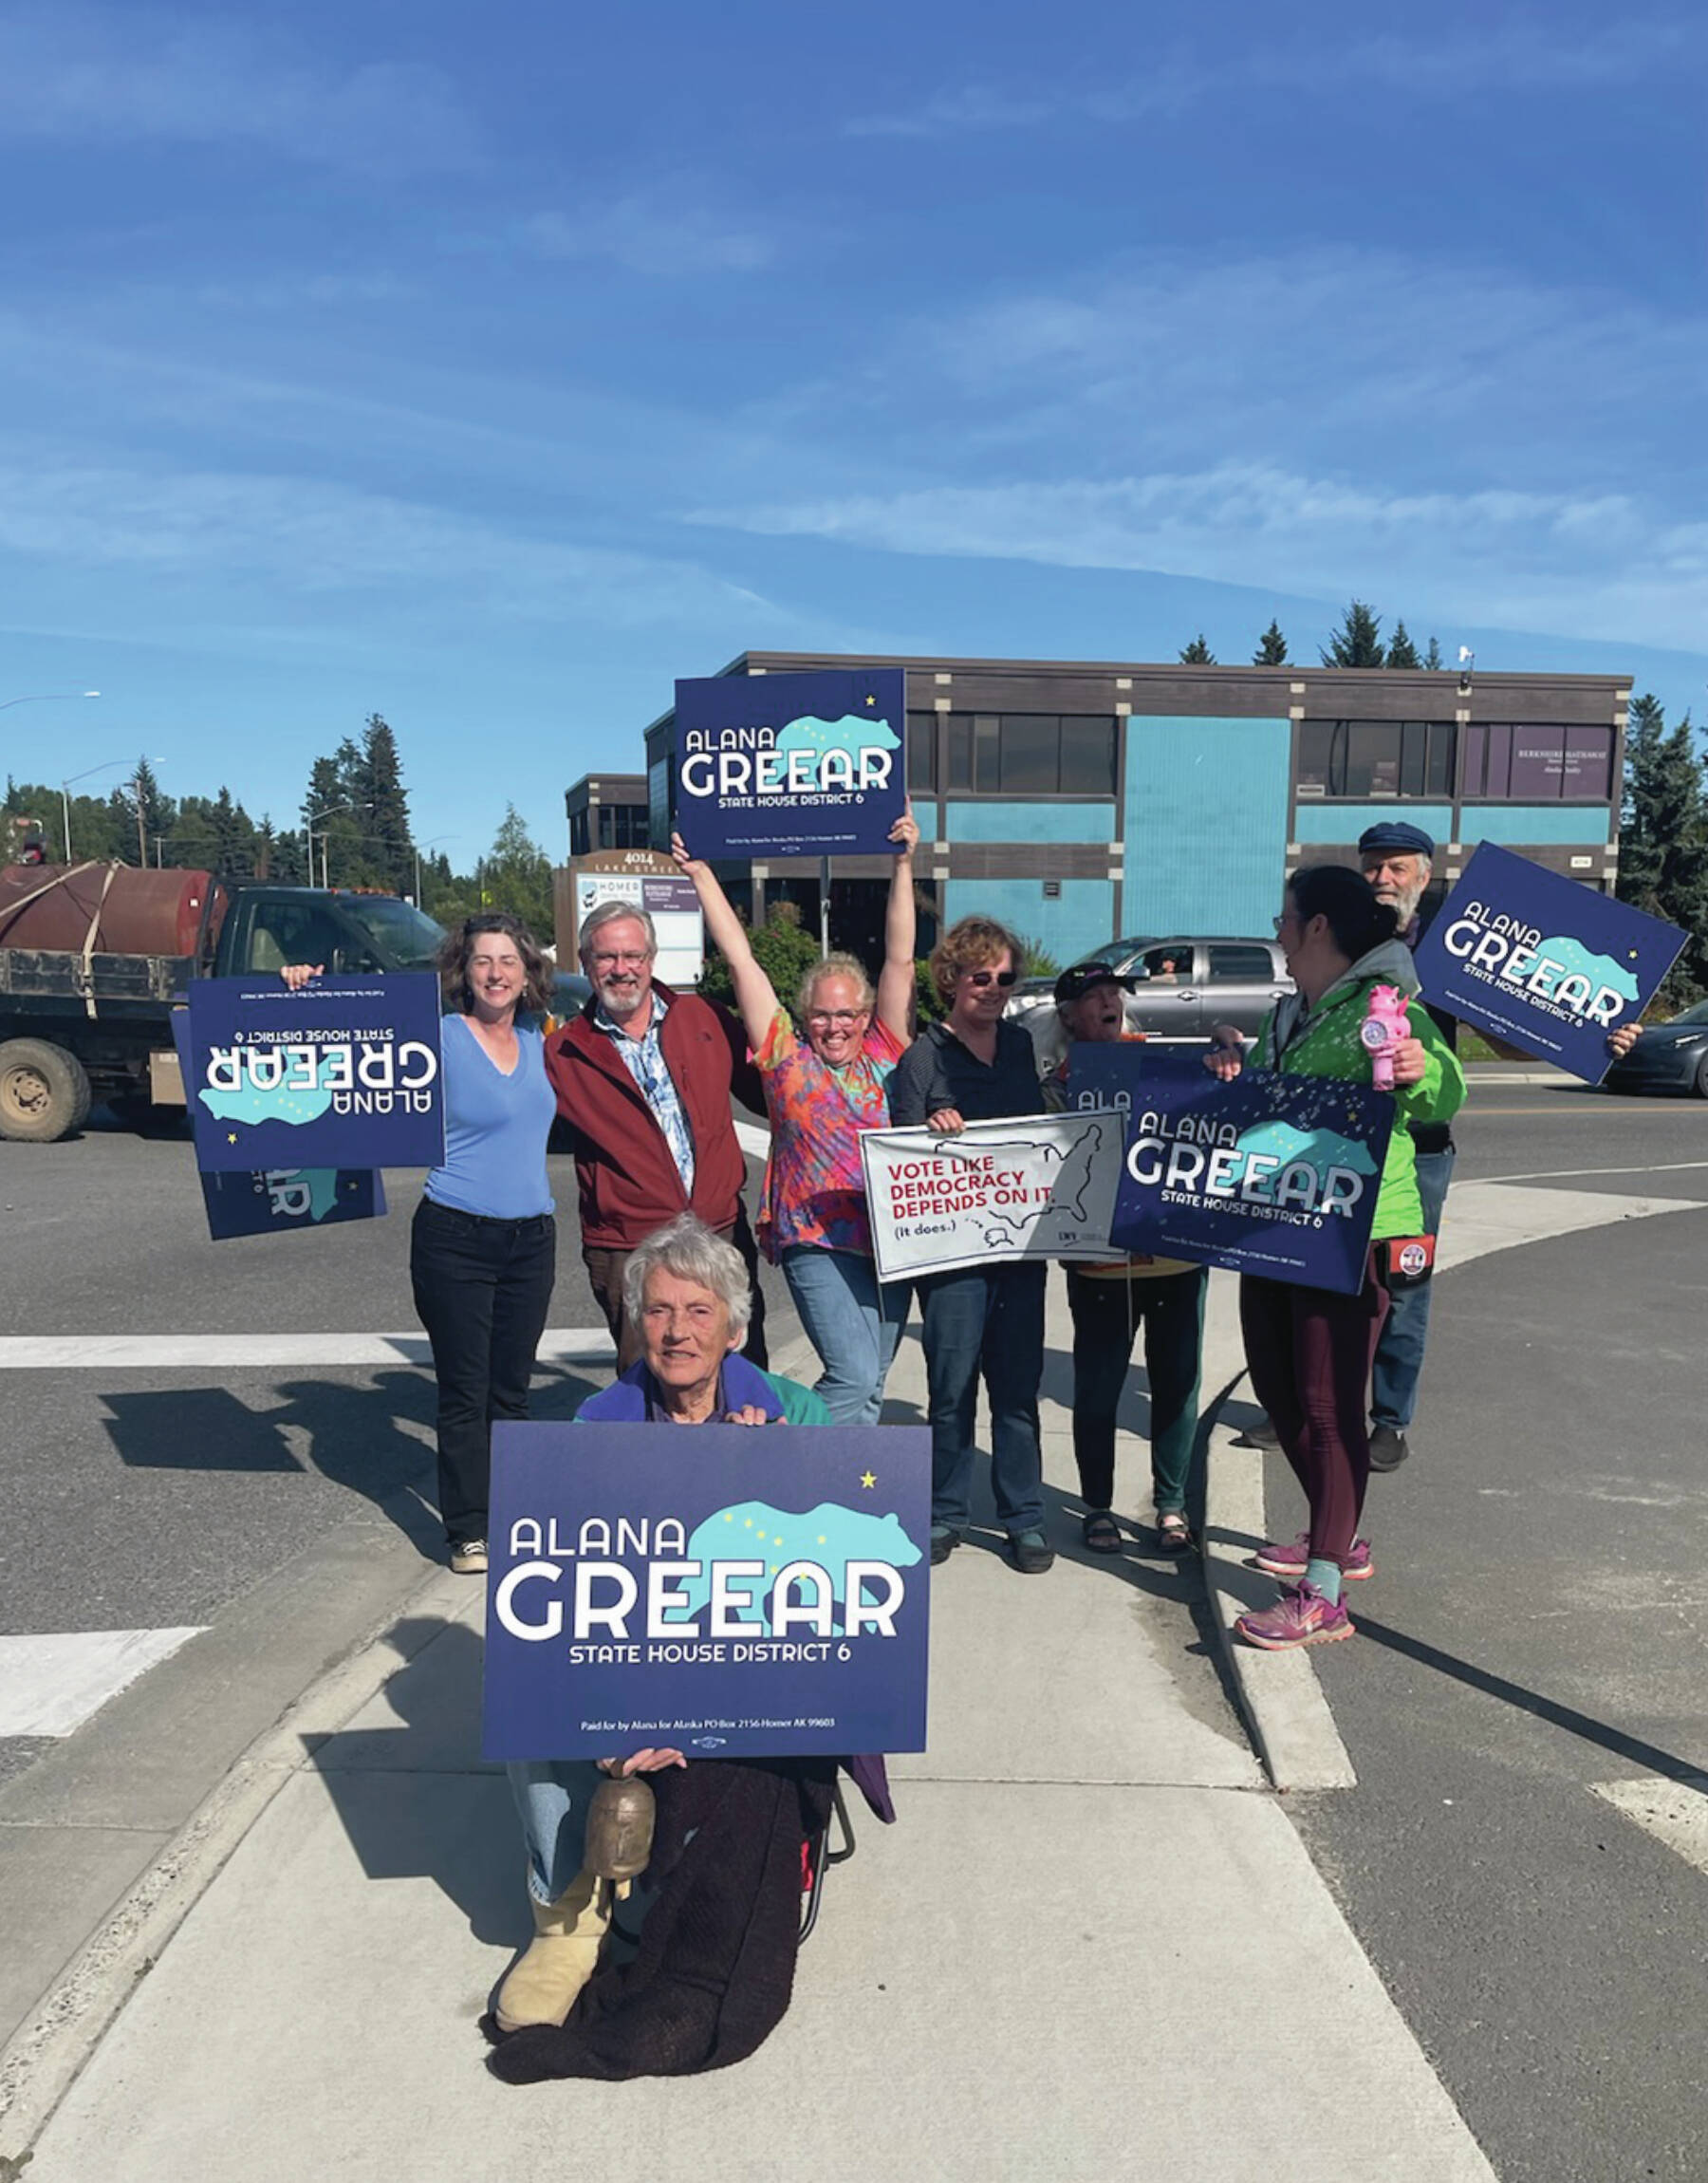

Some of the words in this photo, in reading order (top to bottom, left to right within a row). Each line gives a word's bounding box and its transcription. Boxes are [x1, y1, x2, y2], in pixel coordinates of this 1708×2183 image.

[687, 727, 774, 751] ALANA
[681, 746, 892, 797] GREEAR
[718, 797, 754, 809] STATE
[757, 796, 798, 808] HOUSE
[800, 793, 852, 807] DISTRICT
[856, 794, 864, 804] 6
[595, 864, 626, 873] LAKE
[624, 852, 654, 865] 4014
[1463, 902, 1541, 948] ALANA
[1444, 919, 1624, 1028] GREEAR
[1462, 963, 1494, 986] STATE
[1495, 978, 1530, 1001] HOUSE
[1530, 996, 1576, 1024] DISTRICT
[1575, 1017, 1584, 1029] 6
[235, 1032, 243, 1043] 6
[246, 1030, 302, 1042] DISTRICT
[306, 1029, 350, 1042] HOUSE
[354, 1029, 394, 1041] STATE
[206, 1041, 437, 1091] GREEAR
[333, 1091, 432, 1115] ALANA
[1078, 1090, 1131, 1110] ALA
[1139, 1110, 1236, 1147] ALANA
[888, 1160, 944, 1181] VOTE
[952, 1156, 994, 1174] LIKE
[1126, 1138, 1364, 1219] GREEAR
[890, 1170, 1025, 1201] DEMOCRACY
[893, 1193, 987, 1220] DEPENDS
[993, 1187, 1028, 1205] ON
[1035, 1186, 1055, 1204] IT.
[1161, 1189, 1201, 1209] STATE
[1203, 1196, 1250, 1216] HOUSE
[1251, 1203, 1311, 1226] DISTRICT
[1313, 1217, 1323, 1229] 6
[914, 1220, 956, 1238] does.)
[510, 1518, 686, 1557] ALANA
[494, 1560, 905, 1641] GREEAR
[569, 1644, 640, 1664] STATE
[648, 1644, 726, 1663] HOUSE
[733, 1643, 829, 1663] DISTRICT
[837, 1646, 851, 1662] 6
[581, 1721, 602, 1730] Paid
[603, 1721, 616, 1730] for
[618, 1721, 629, 1732] by
[631, 1720, 658, 1730] Alana
[659, 1720, 672, 1729] for
[673, 1719, 702, 1730] Alaska
[704, 1719, 717, 1728] PO
[718, 1719, 735, 1728] Box
[761, 1719, 792, 1728] Homer
[793, 1718, 807, 1727] AK
